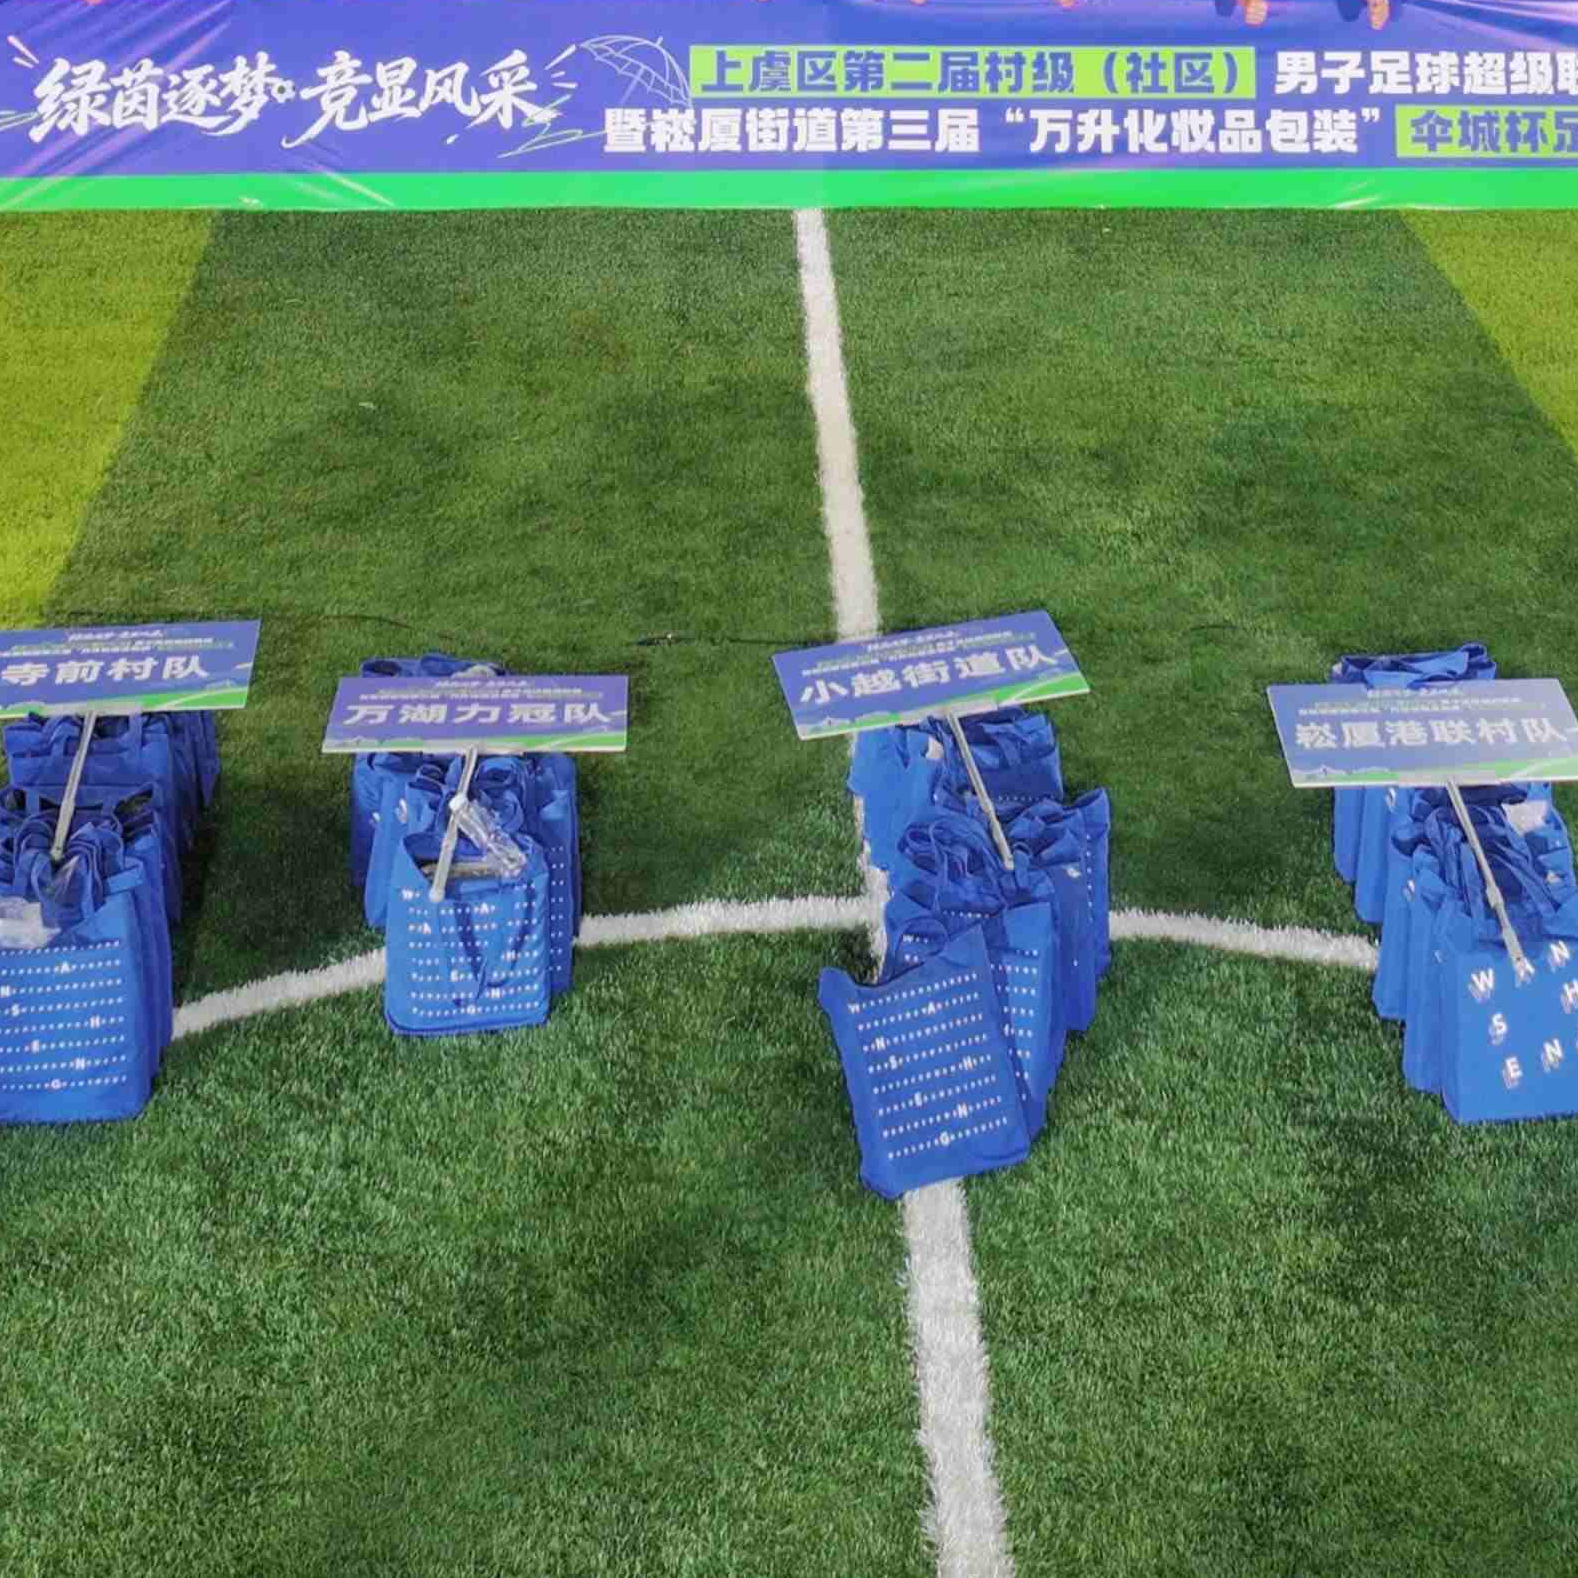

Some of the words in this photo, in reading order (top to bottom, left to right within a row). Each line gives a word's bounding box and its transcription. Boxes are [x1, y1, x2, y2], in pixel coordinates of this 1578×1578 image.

[31, 51, 280, 140] 绿茵逐梦
[281, 50, 545, 149] 竞显风采
[0, 654, 211, 687] 寺前村队
[800, 643, 1060, 706] 小越街道队
